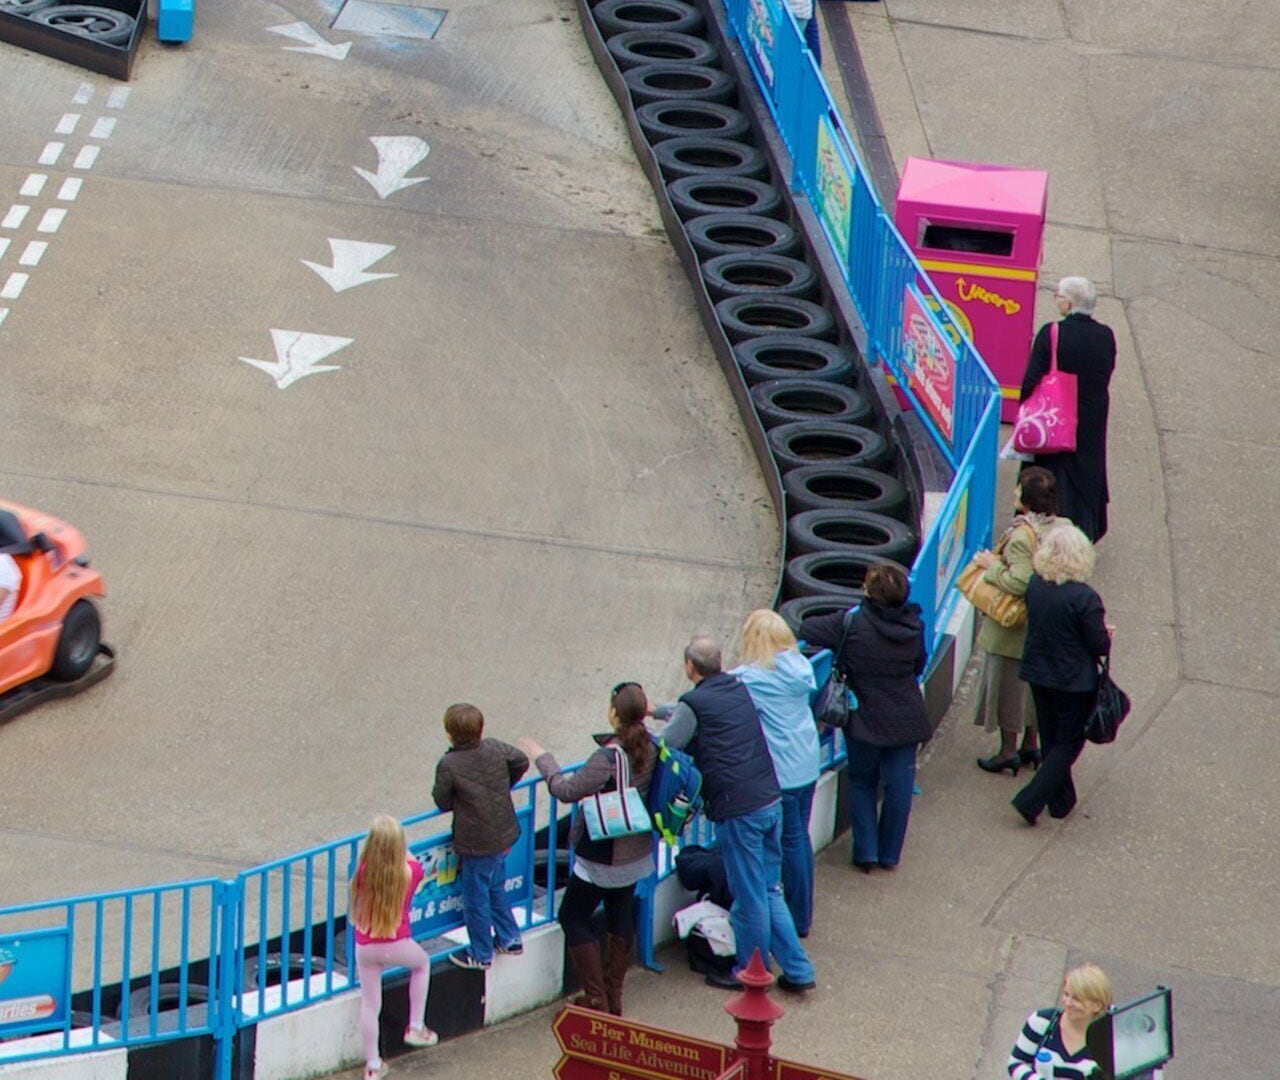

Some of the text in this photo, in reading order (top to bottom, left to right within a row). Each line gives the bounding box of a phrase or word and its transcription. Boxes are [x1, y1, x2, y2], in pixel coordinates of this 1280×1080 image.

[425, 900, 436, 919] &
[570, 1033, 718, 1080] Sea Life Adventure
[589, 1019, 701, 1061] Pier Museum
